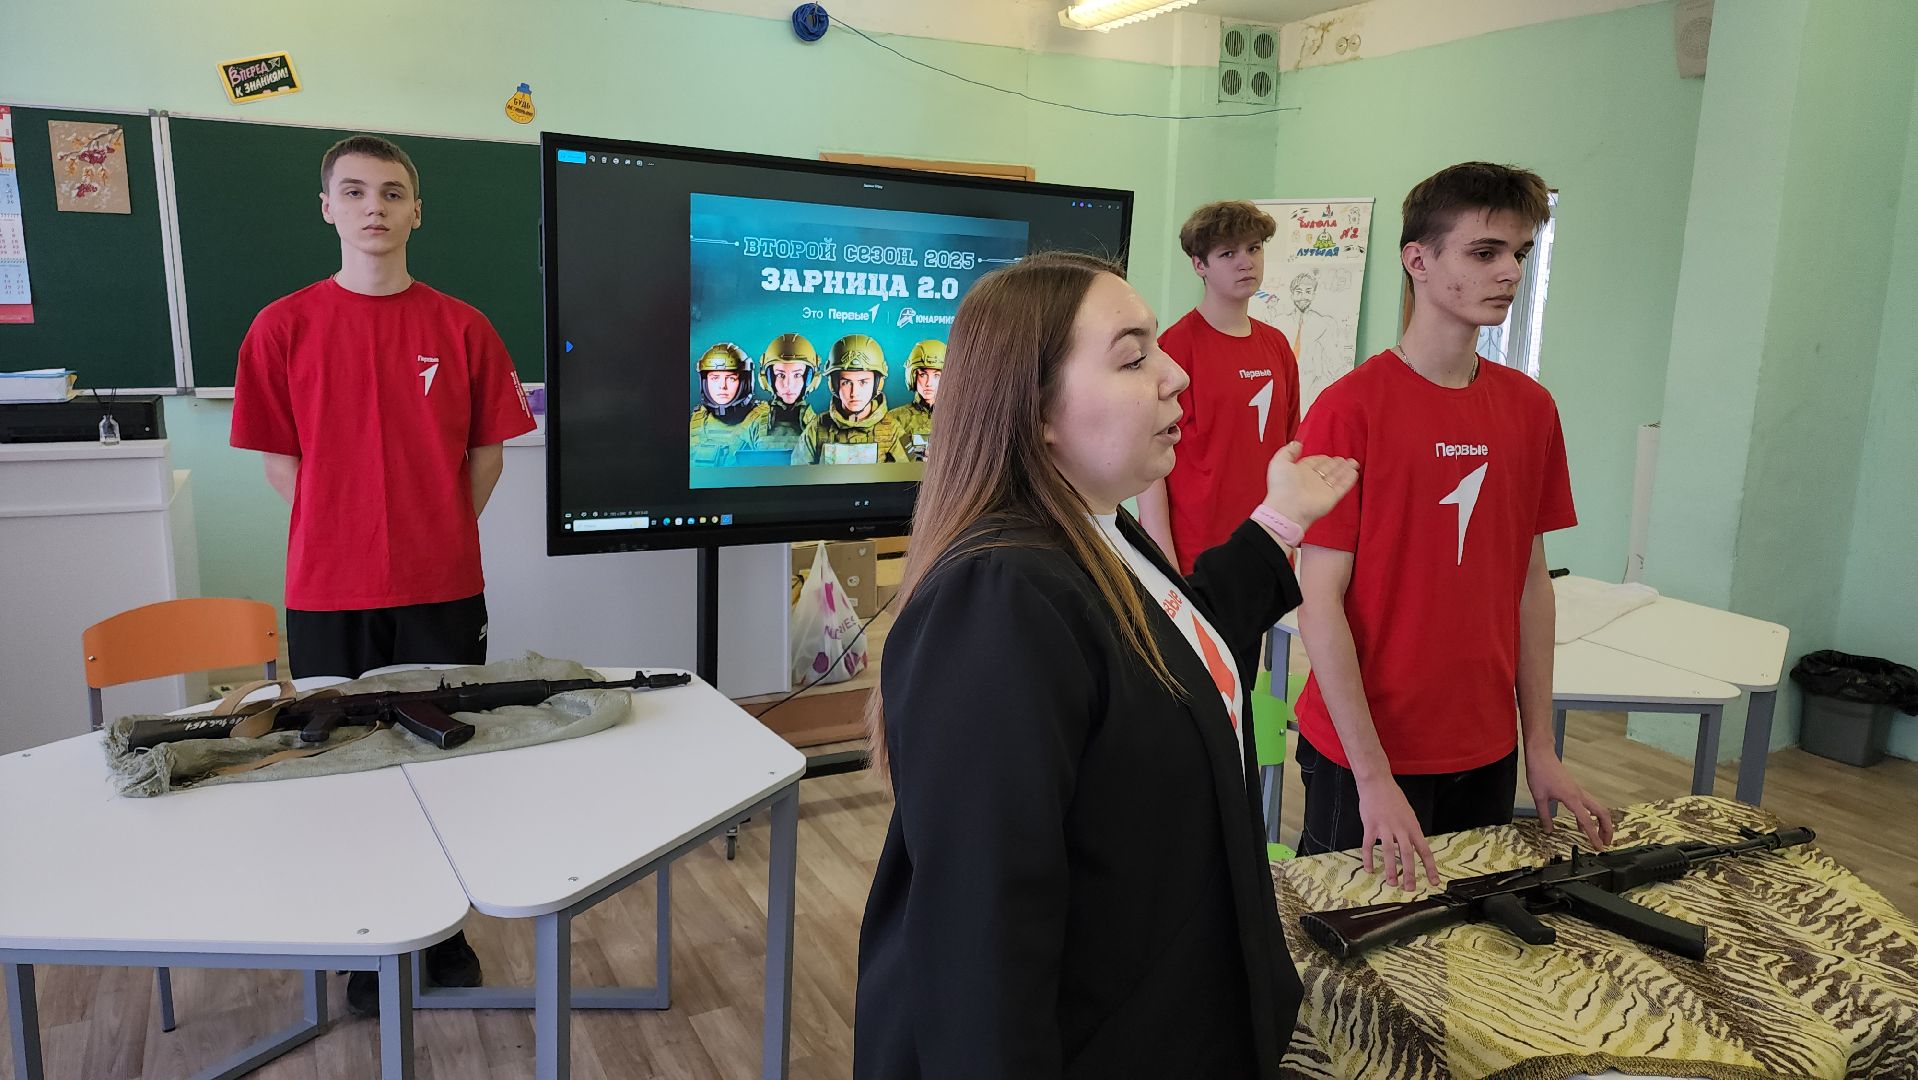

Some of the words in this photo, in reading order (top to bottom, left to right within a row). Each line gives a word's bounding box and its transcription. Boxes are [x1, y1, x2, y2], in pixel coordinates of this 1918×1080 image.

[235, 86, 243, 97] К
[244, 67, 289, 93] ЗНАНИЯМ!
[744, 237, 836, 261] ВТОРОЙ
[923, 249, 975, 269] 2025
[761, 267, 910, 301] ЗАРНИЦА
[917, 276, 959, 299] 2.0
[802, 307, 824, 319] Это
[828, 308, 869, 323] Первые
[1238, 369, 1272, 380] Первые
[1435, 442, 1488, 460] Первые
